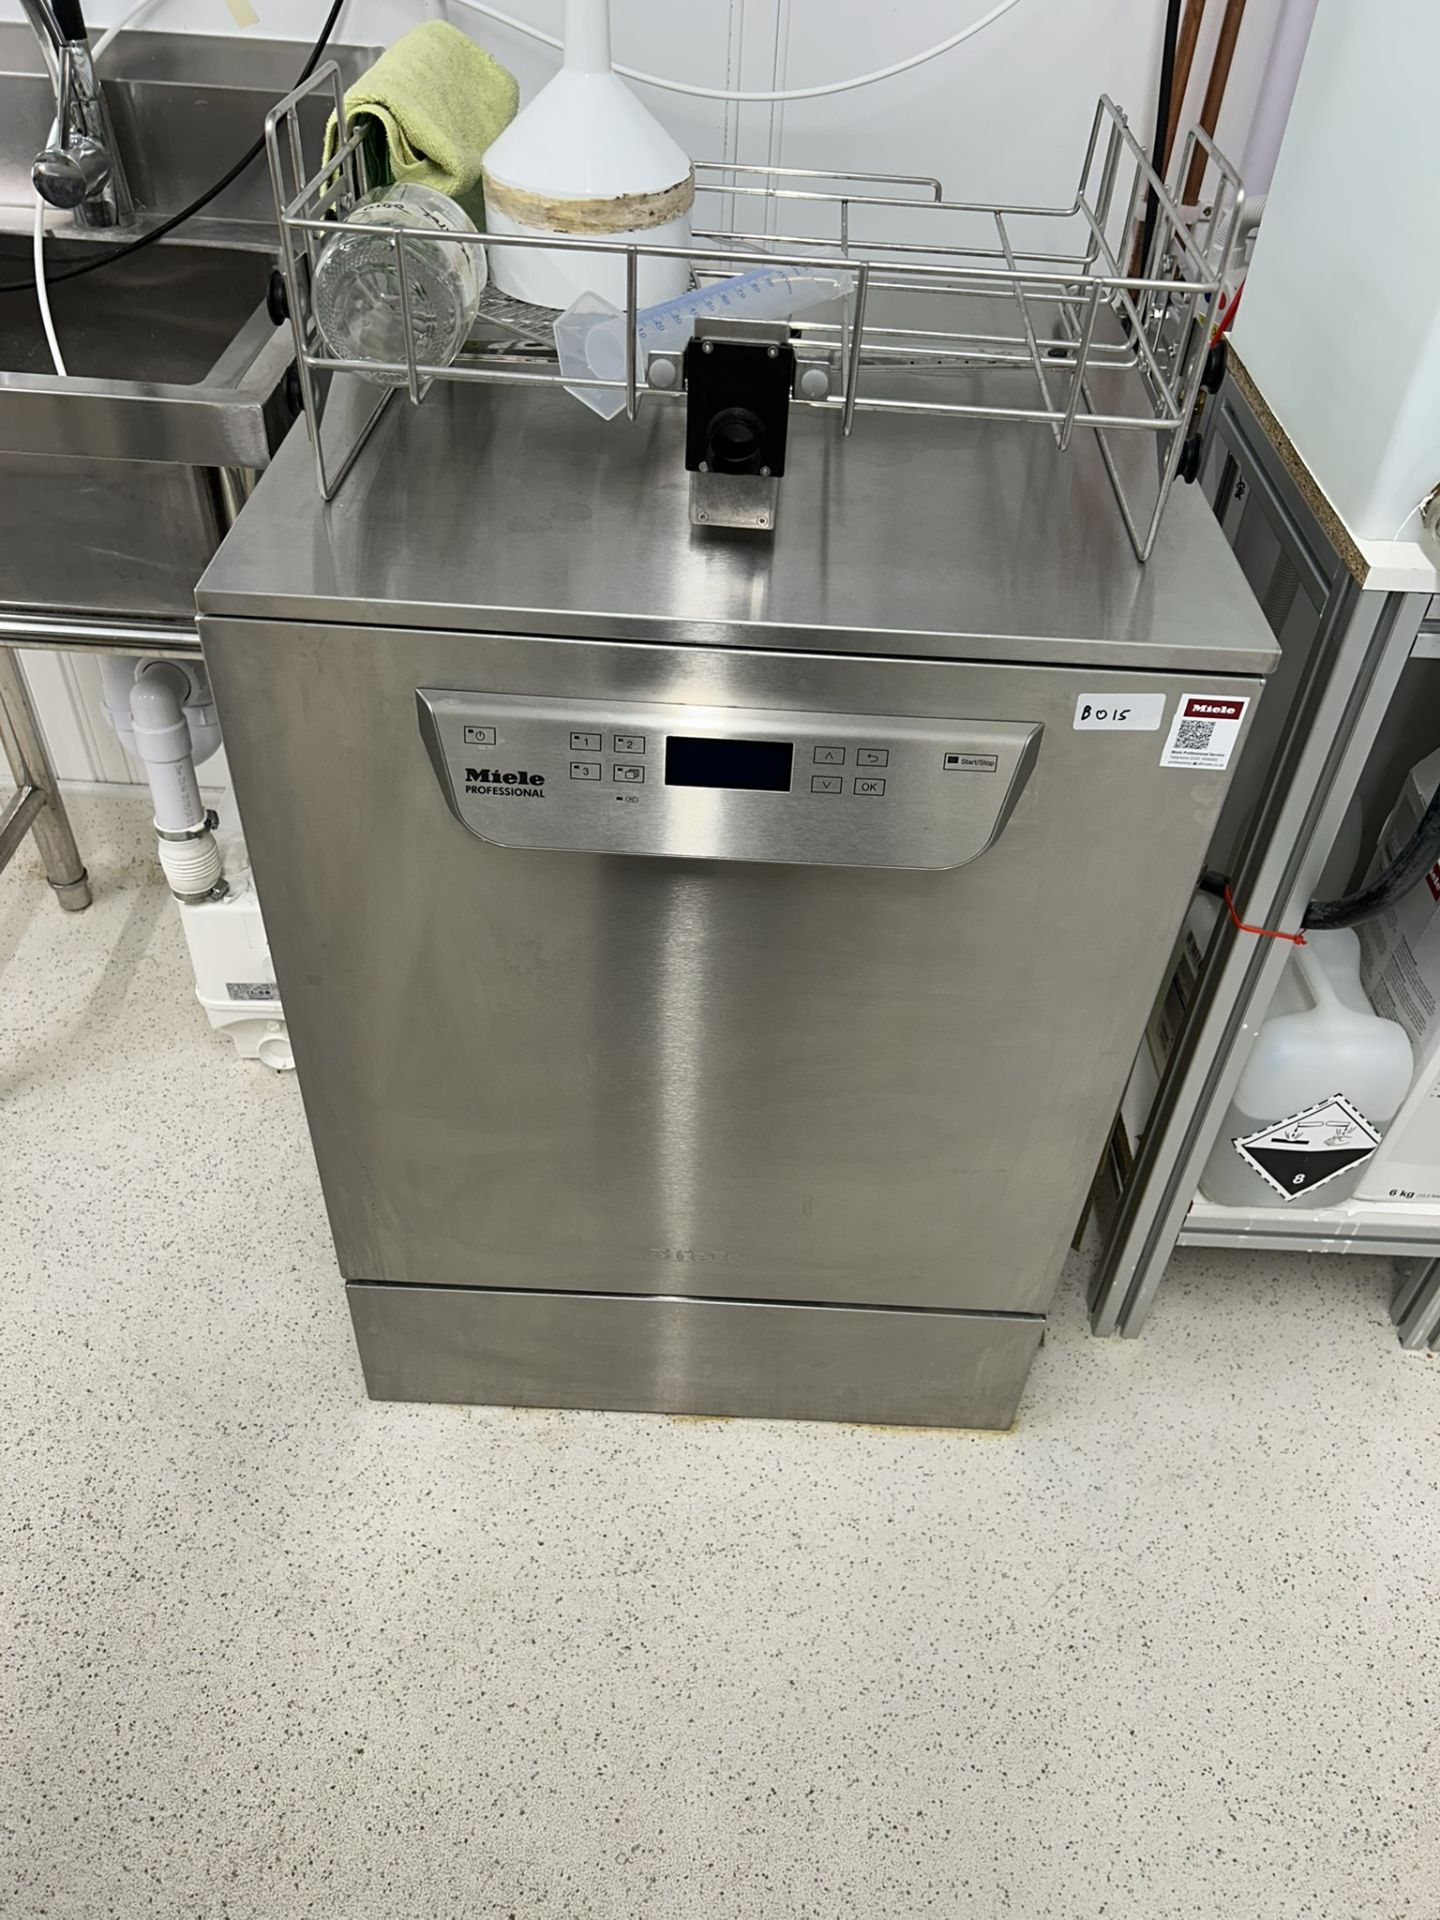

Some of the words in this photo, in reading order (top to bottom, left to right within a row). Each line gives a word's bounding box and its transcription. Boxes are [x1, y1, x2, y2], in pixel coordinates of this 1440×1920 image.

[654, 318, 665, 332] 20
[638, 327, 647, 339] 10
[1191, 704, 1237, 715] Miele
[584, 738, 589, 747] 1
[626, 741, 633, 749] 2
[961, 758, 995, 768] Start/Stop
[582, 767, 589, 776] 3
[465, 768, 545, 786] Miele
[465, 785, 545, 798] PROFESSIONAL
[861, 782, 878, 792] OK
[1293, 1173, 1306, 1184] 8
[1388, 1189, 1398, 1197] 6
[1399, 1190, 1415, 1199] kg
